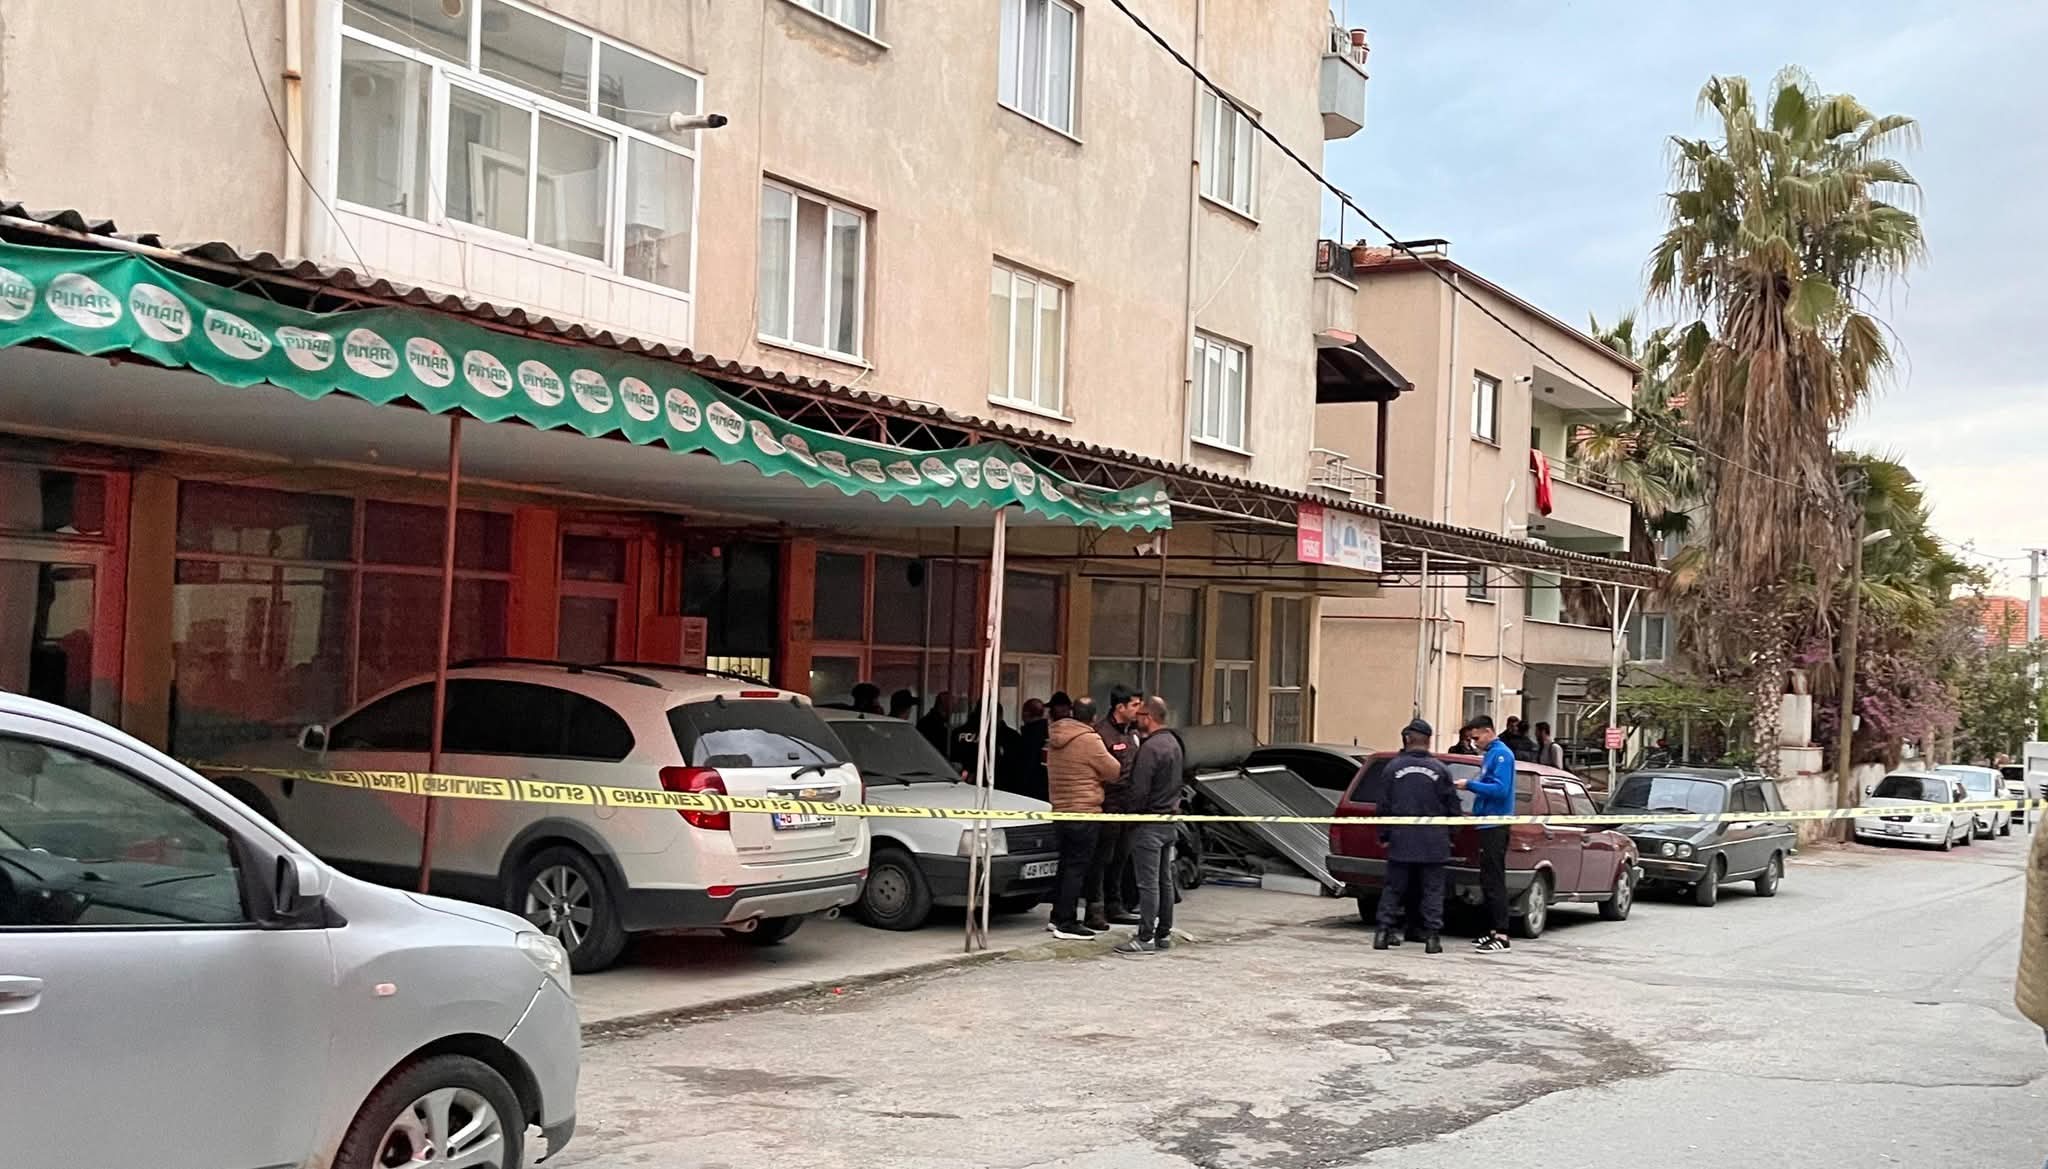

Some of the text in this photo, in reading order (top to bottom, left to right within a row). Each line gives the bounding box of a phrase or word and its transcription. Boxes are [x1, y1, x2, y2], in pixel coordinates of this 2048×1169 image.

[51, 289, 112, 309] PINAR
[133, 300, 184, 325] PINAR
[347, 343, 392, 360] PINAR
[409, 351, 449, 371] PINAR
[467, 363, 507, 382] PINAR
[523, 373, 560, 391] PINAR
[575, 382, 608, 398] PINAR
[709, 412, 742, 431] PINAR
